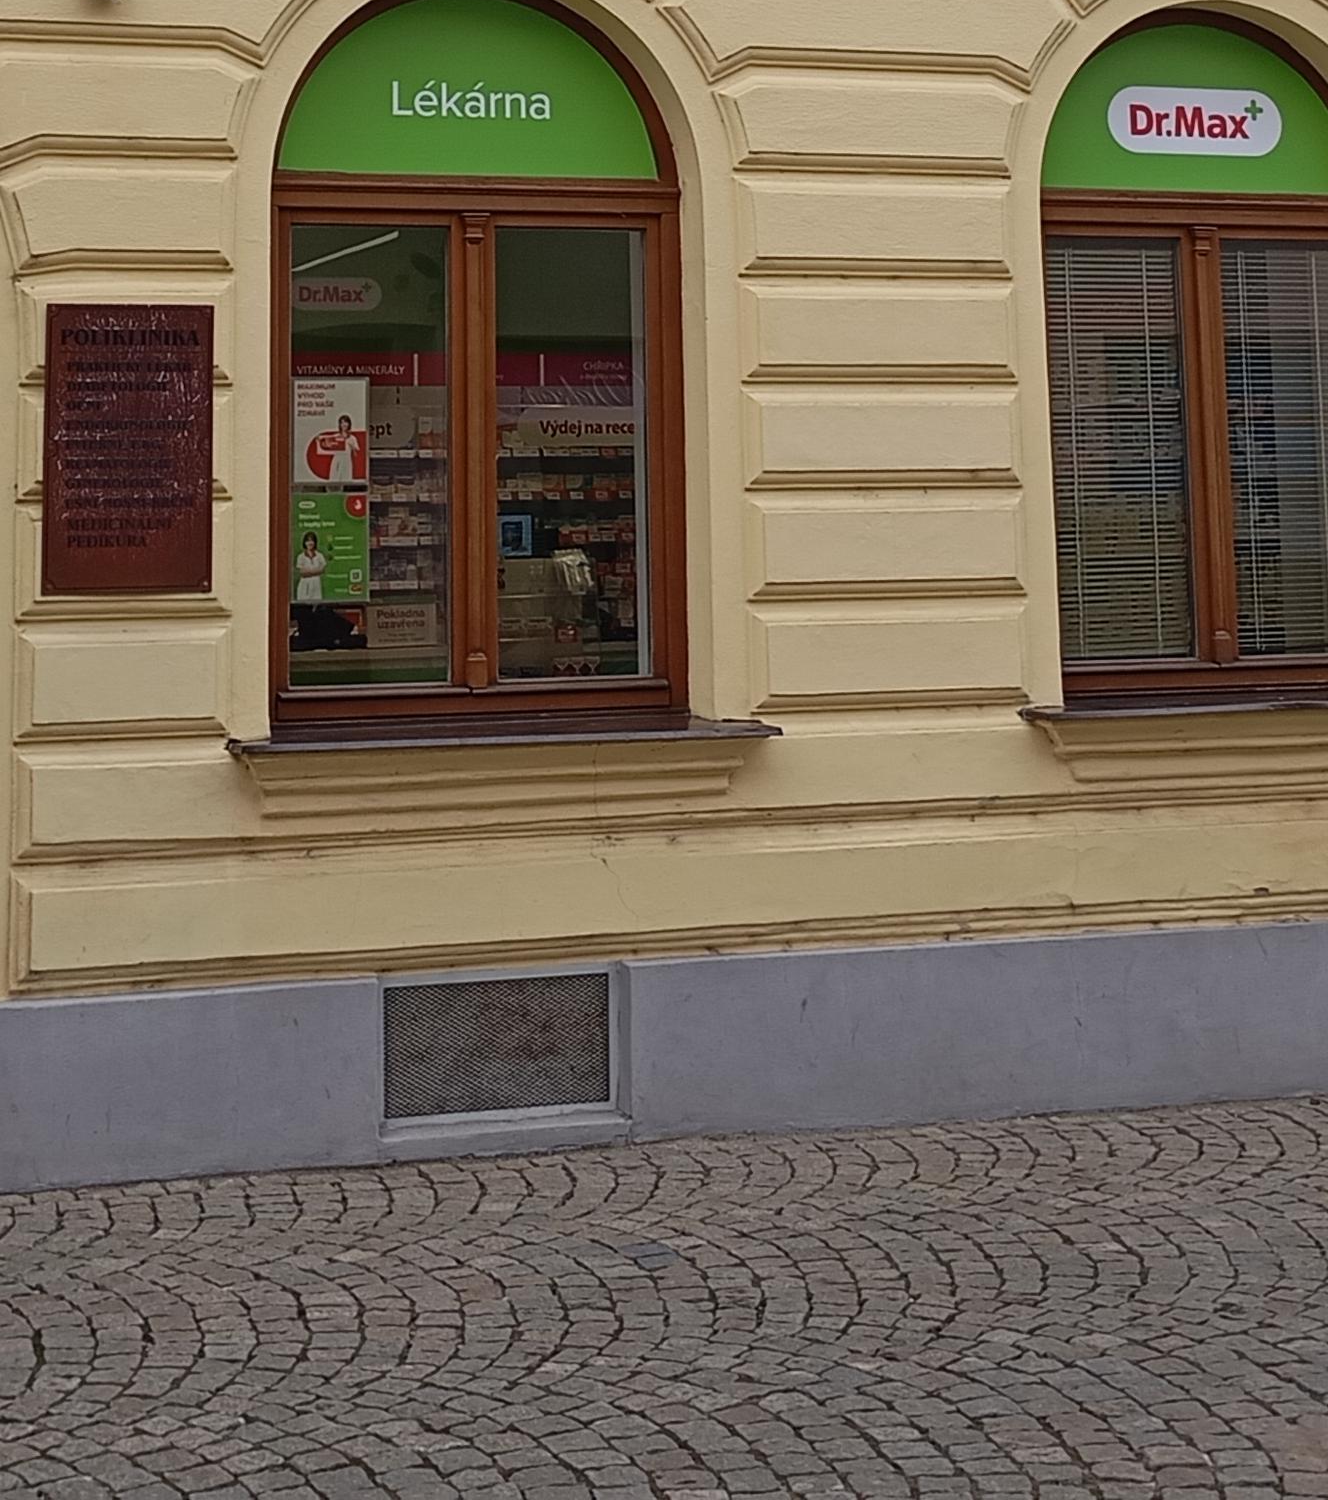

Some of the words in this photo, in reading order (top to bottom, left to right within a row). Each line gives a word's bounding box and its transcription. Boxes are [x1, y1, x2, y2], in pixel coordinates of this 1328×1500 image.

[391, 79, 552, 120] Lékárna
[60, 328, 200, 346] POLIKLINIKA
[346, 366, 354, 375] A
[356, 364, 406, 375] MINERÁLY
[539, 419, 582, 438] Výdej
[584, 423, 604, 435] na
[377, 608, 426, 619] Pokladna
[377, 619, 426, 630] uzavřena
